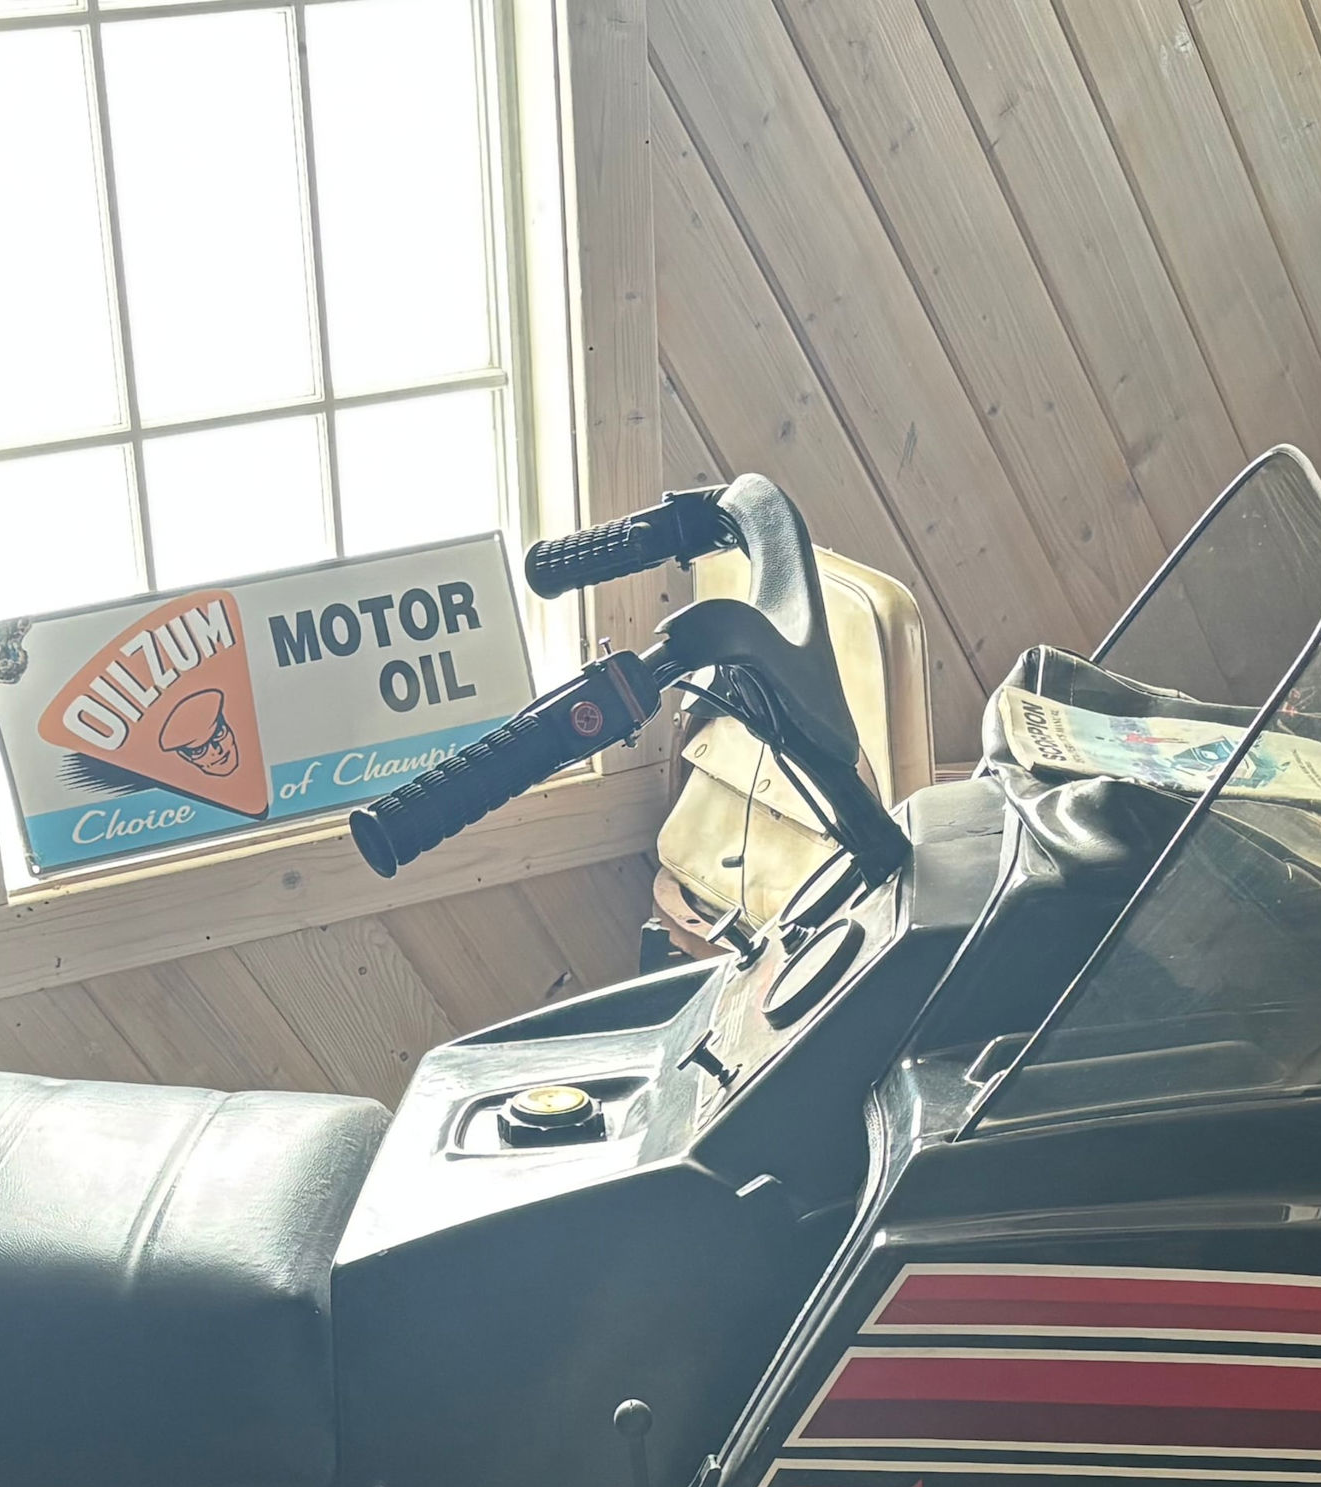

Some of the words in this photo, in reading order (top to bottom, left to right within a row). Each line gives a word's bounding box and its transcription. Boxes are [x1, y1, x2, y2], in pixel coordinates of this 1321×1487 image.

[268, 581, 482, 668] MOTOR
[62, 599, 236, 750] OILZUM
[379, 651, 477, 713] OIL
[72, 804, 196, 844] Choice
[280, 761, 322, 799] of
